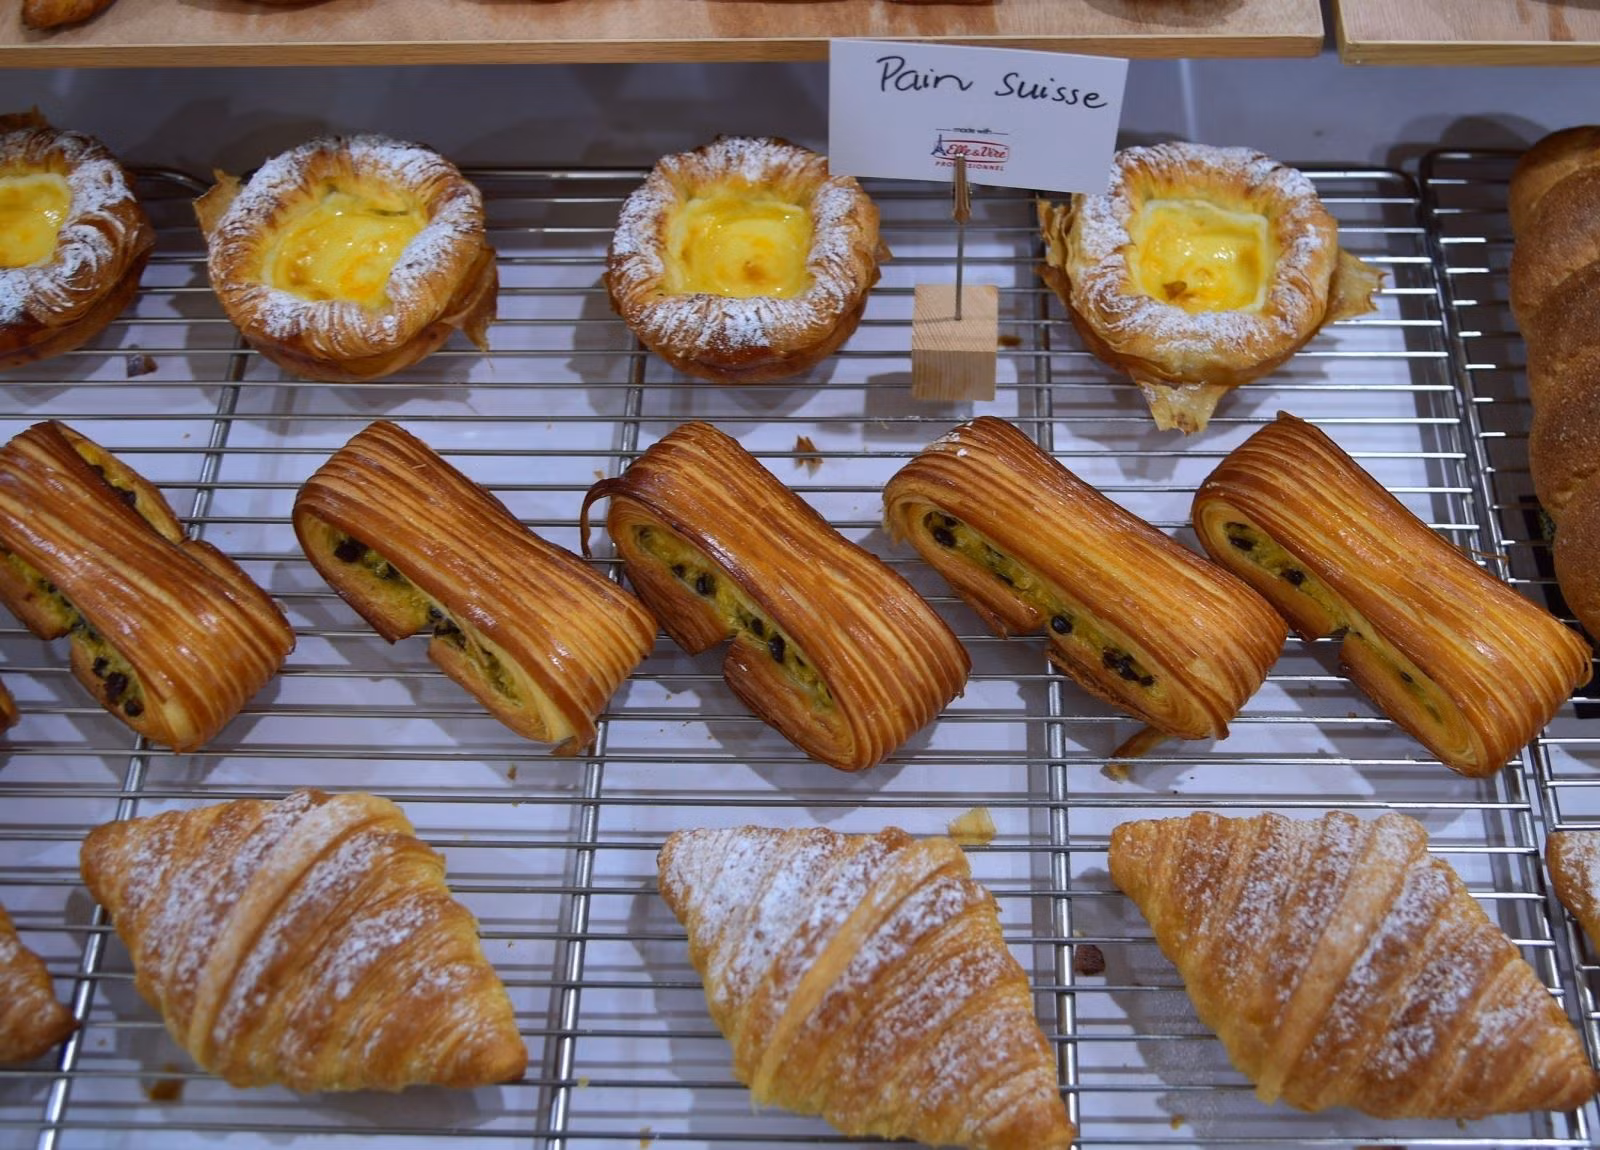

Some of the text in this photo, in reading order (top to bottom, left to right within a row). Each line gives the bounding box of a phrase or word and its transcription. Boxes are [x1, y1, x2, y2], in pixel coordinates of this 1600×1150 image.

[876, 55, 1108, 109] Pain Suisse
[935, 161, 1004, 171] PROSIONNEL
